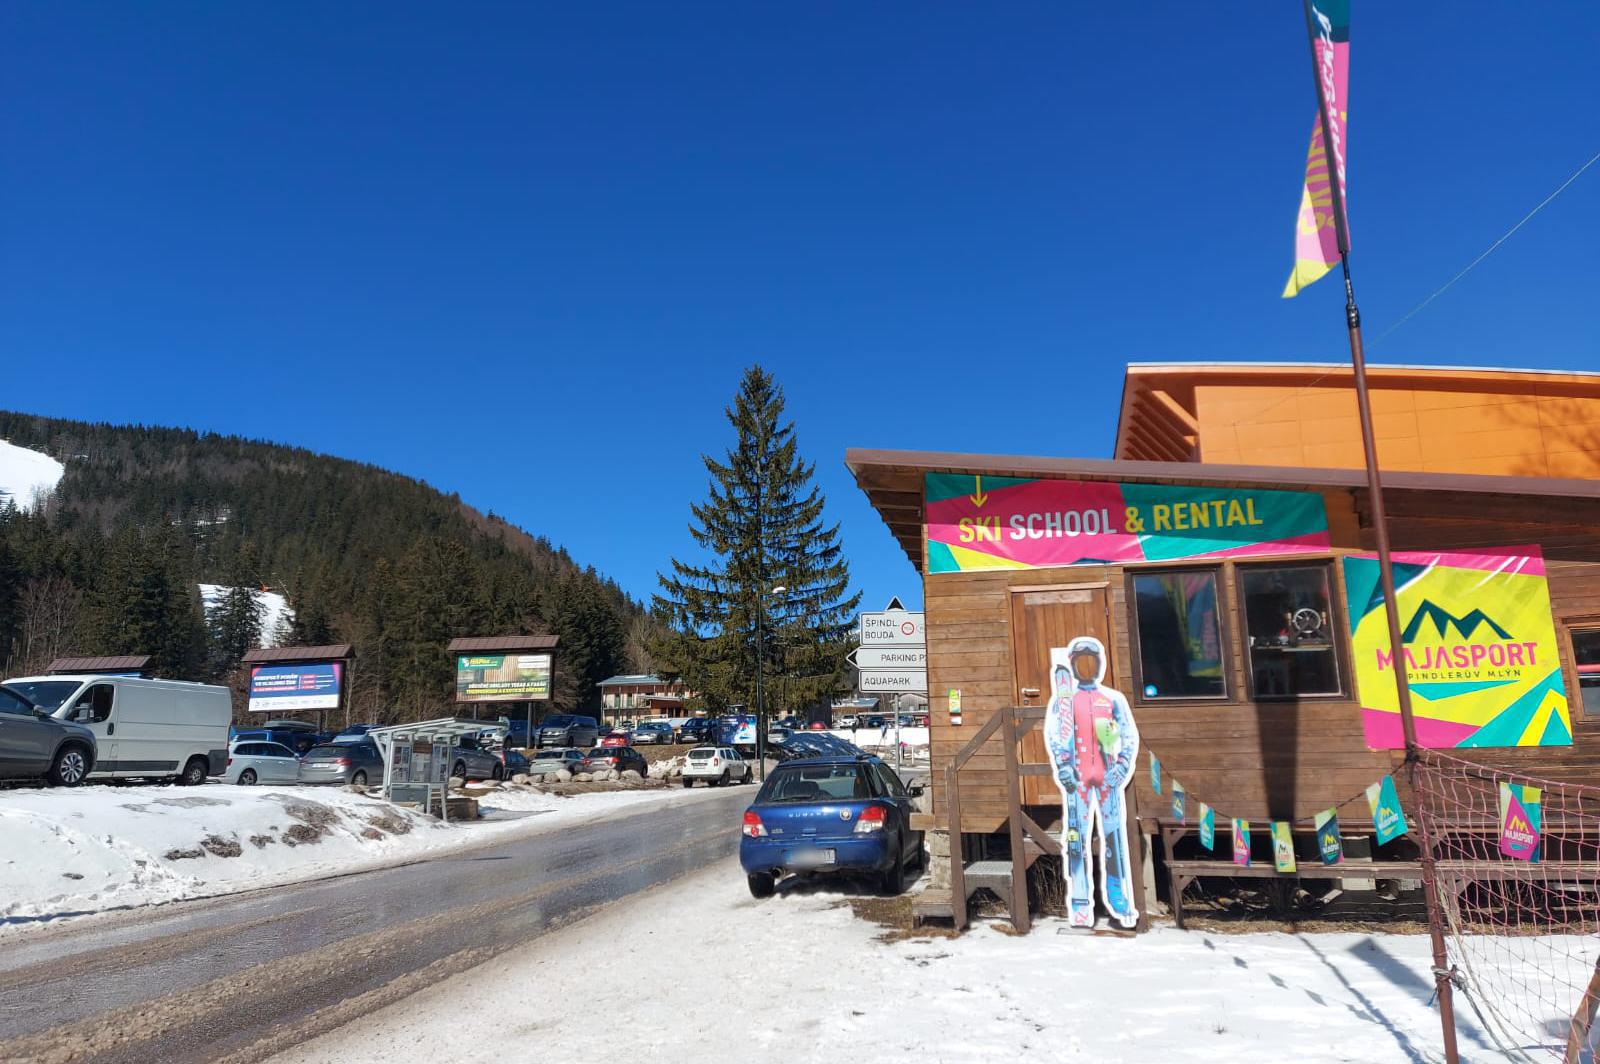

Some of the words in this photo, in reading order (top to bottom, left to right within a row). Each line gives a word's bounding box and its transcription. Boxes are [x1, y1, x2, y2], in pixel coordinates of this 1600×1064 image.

[959, 515, 1002, 543] SKI
[1009, 508, 1118, 540] SCHOOL
[1124, 506, 1146, 533] &
[1152, 498, 1264, 531] RENTAL
[865, 631, 895, 639] BOUDA
[881, 654, 917, 662] PARKING
[1407, 670, 1480, 680] PINDLERŮV
[1487, 668, 1521, 678] MLÝN
[864, 677, 911, 686] AQUAPARK
